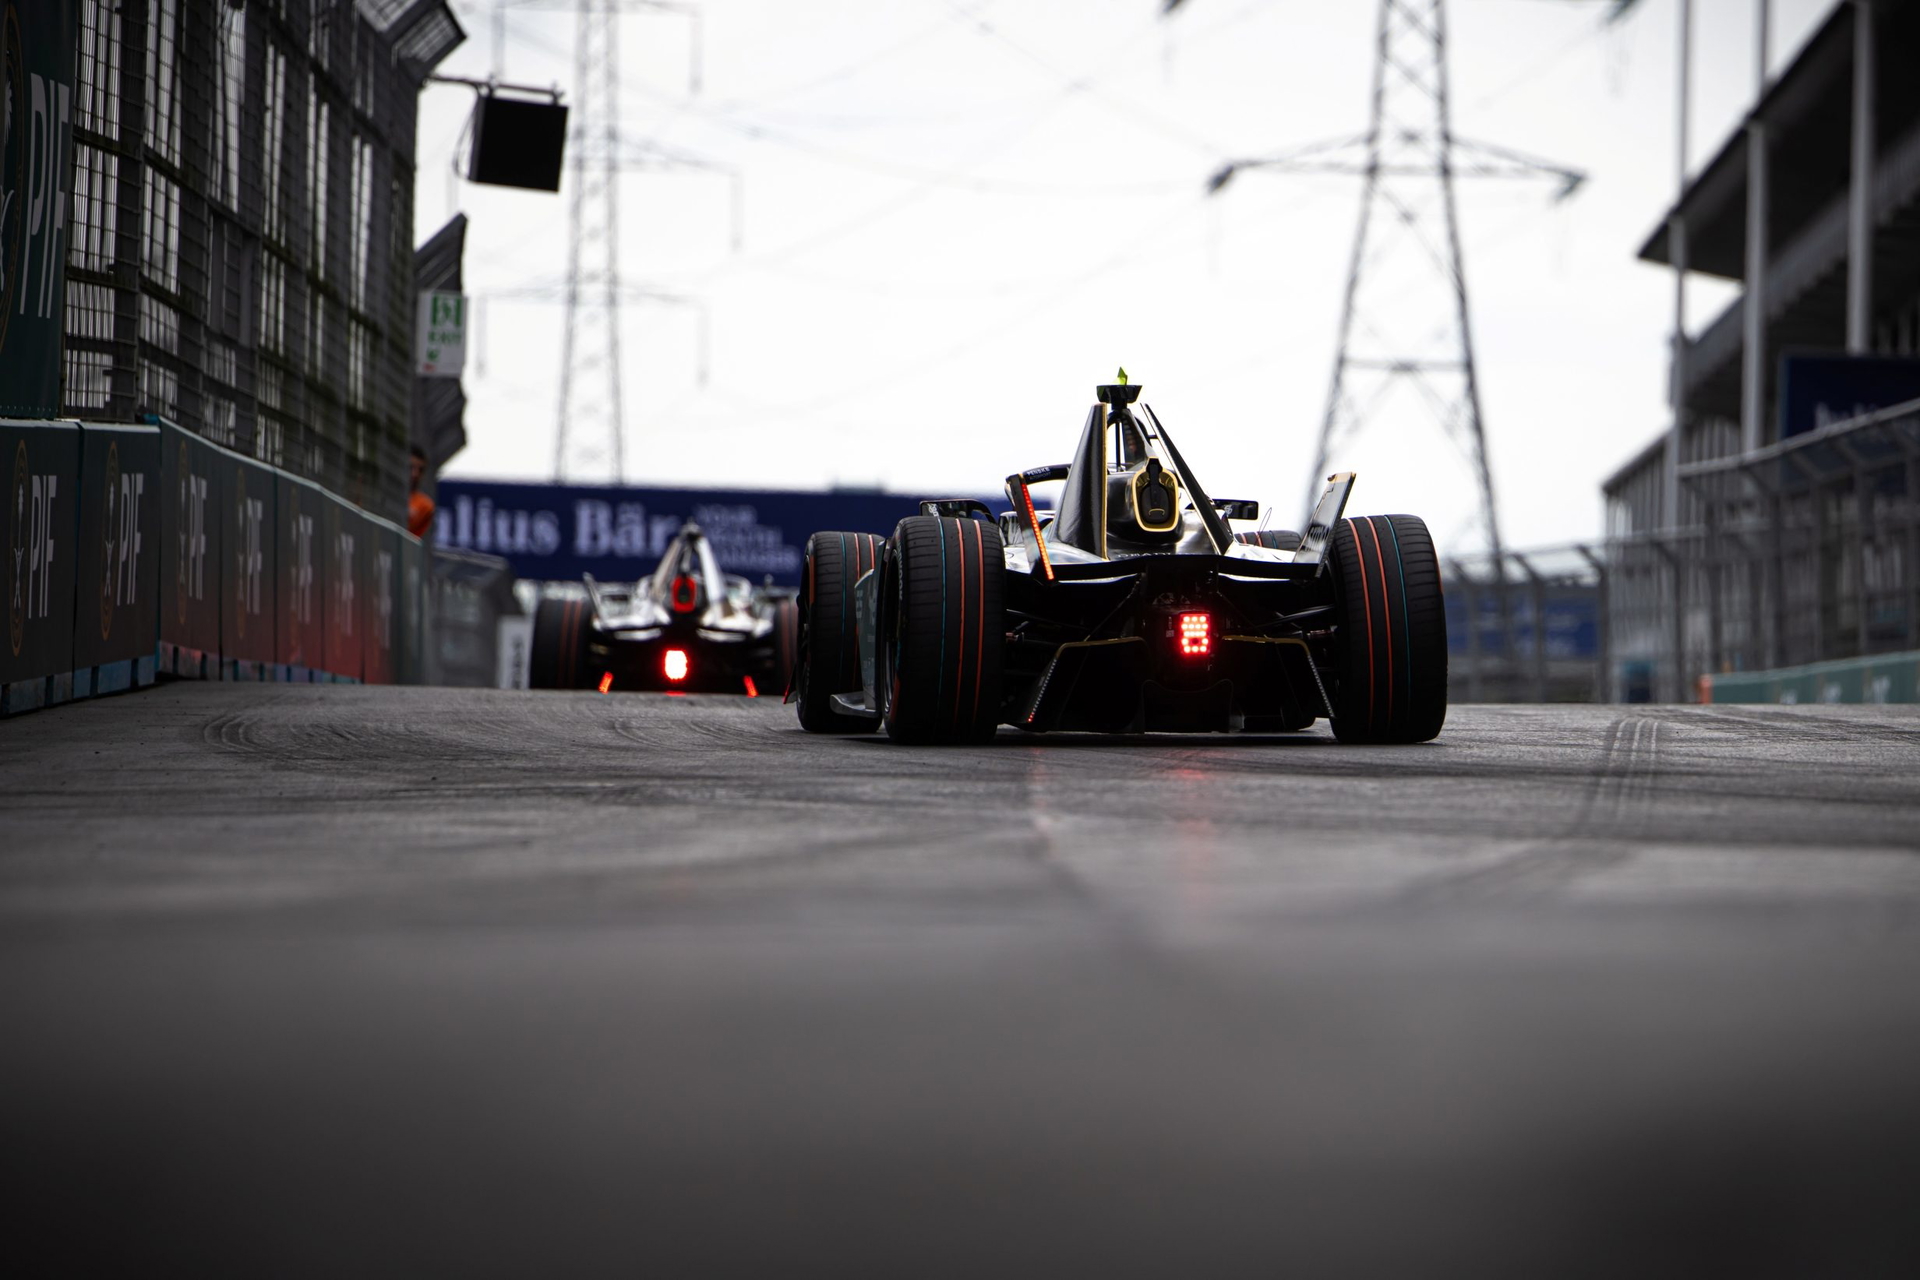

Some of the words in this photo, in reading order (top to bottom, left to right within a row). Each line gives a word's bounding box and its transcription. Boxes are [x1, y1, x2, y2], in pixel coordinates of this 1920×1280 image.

[20, 72, 69, 319] PIF
[29, 475, 57, 619] PIF
[117, 473, 143, 606] PIF
[189, 473, 207, 600] PIF
[247, 497, 262, 615] PIF
[575, 499, 680, 557] Bär
